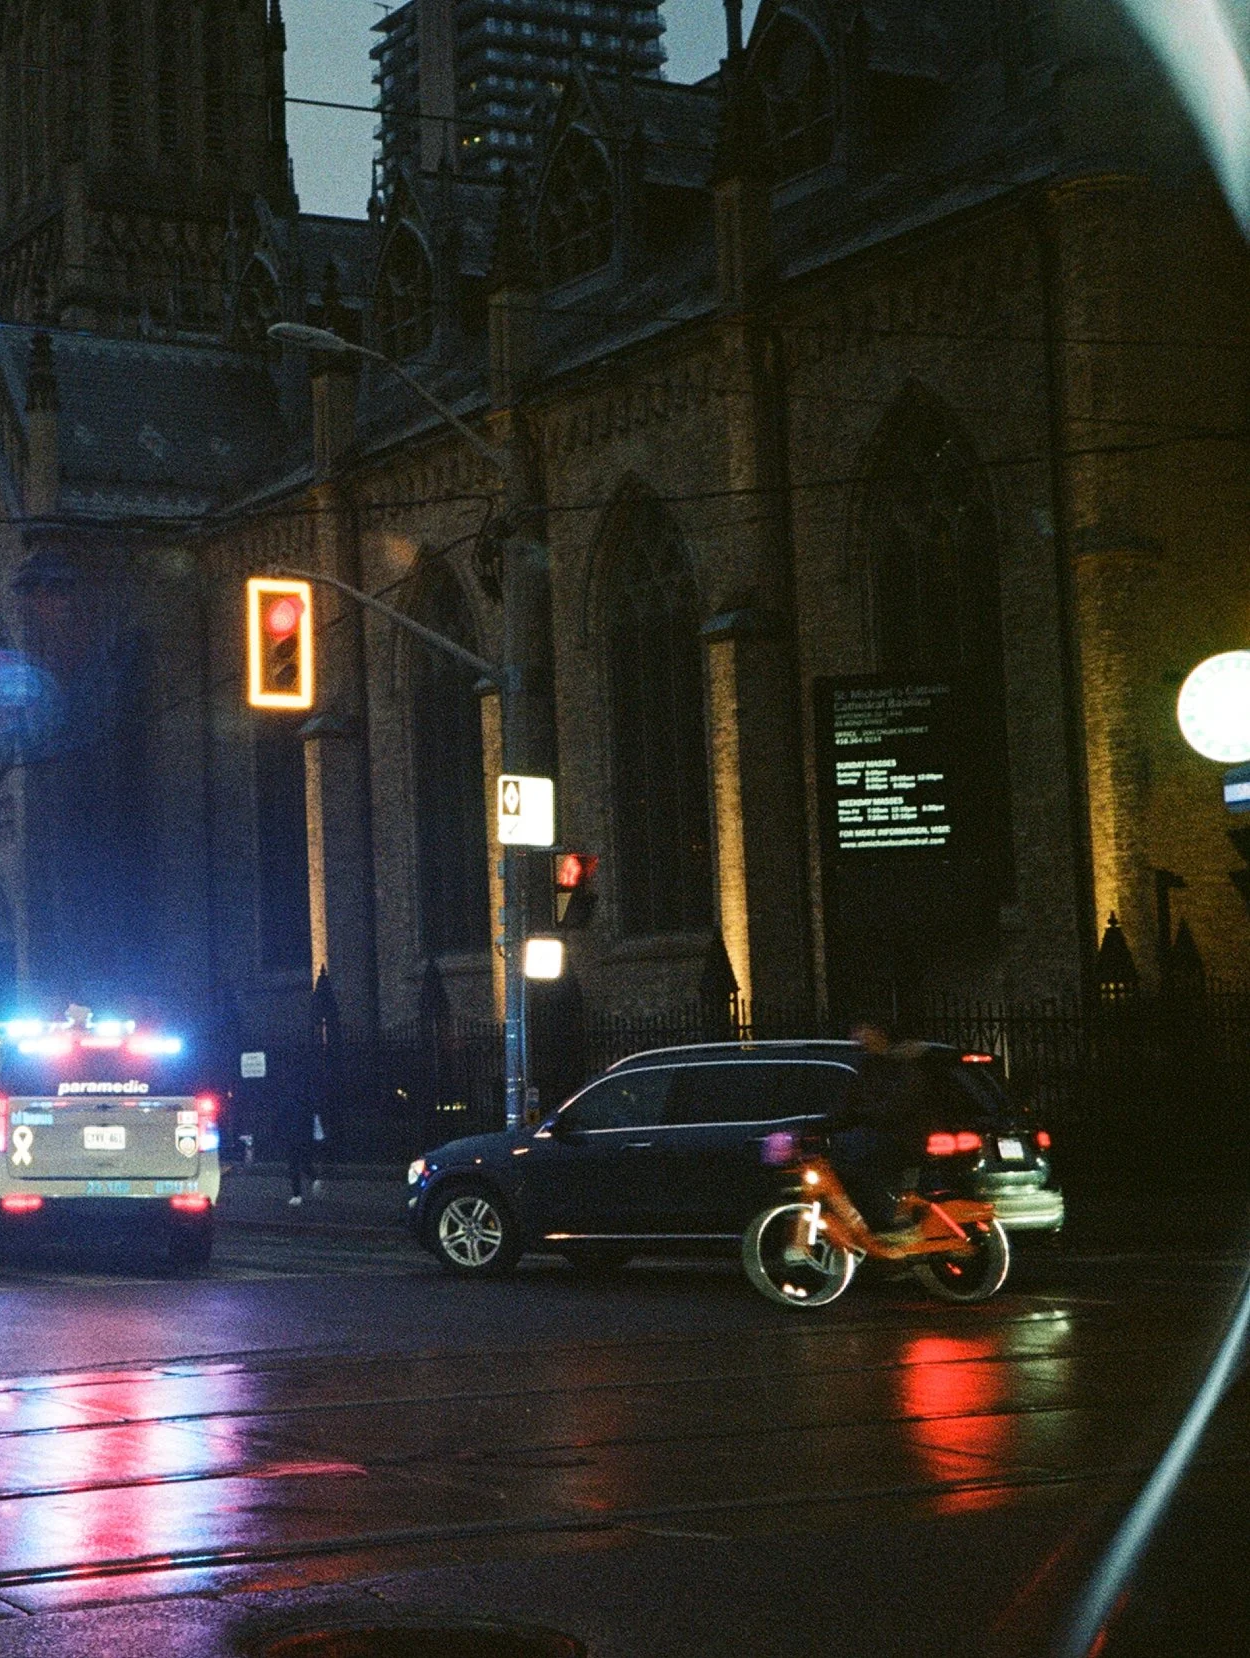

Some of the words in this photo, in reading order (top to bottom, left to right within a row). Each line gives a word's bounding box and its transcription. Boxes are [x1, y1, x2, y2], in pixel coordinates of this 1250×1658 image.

[904, 726, 928, 734] STREET
[836, 760, 865, 770] SUNDAY
[866, 758, 897, 768] MASSES
[838, 798, 872, 807] WEEKDAY
[872, 796, 904, 806] MASSES
[839, 829, 854, 838] FOR
[855, 828, 876, 838] MORE
[57, 1080, 149, 1096] paramedic
